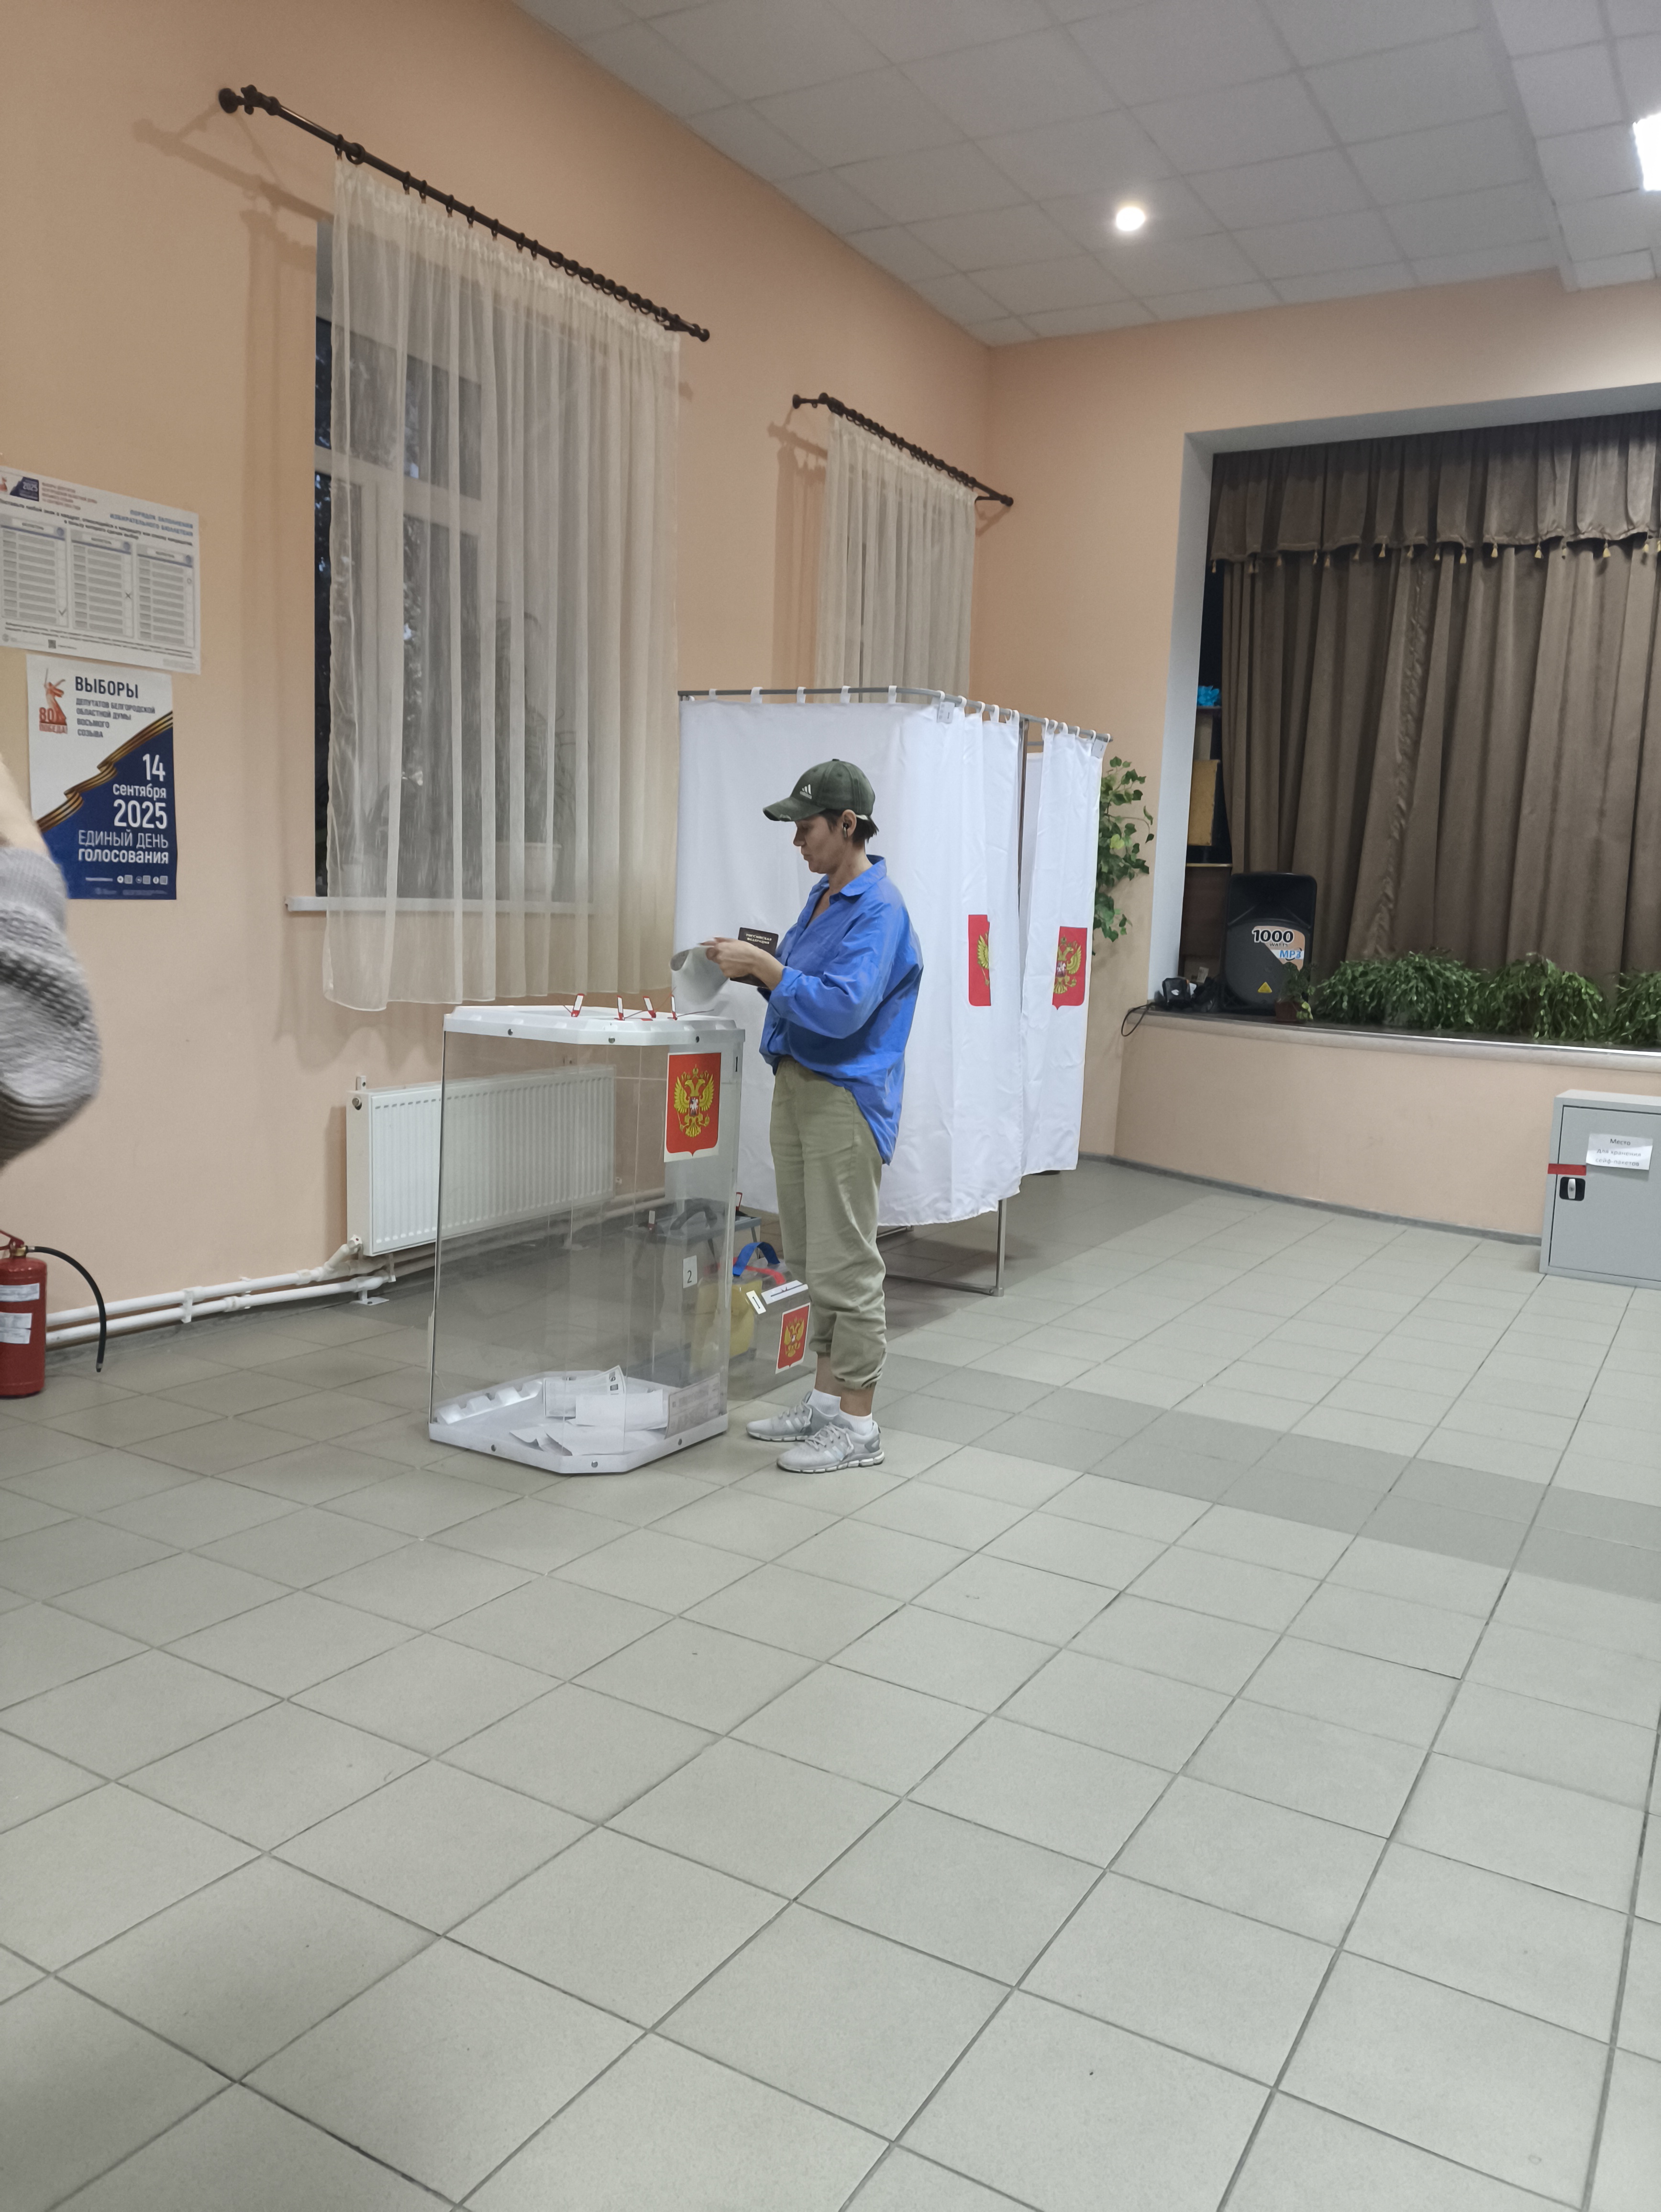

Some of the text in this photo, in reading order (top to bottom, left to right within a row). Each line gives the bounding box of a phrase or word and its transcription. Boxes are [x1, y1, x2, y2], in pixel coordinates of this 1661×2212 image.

[23, 482, 38, 492] 2025
[75, 676, 139, 698] ВЫБОРЫ
[76, 698, 155, 714] ДЕПУТАТОВ БЕЛГОРОДСКОЙ
[76, 708, 111, 718] ОБЛАСТНОЙ
[39, 707, 54, 723] 80
[77, 718, 110, 728] ВОСЬМОГО
[78, 729, 103, 738] СОЗЫВА
[142, 754, 166, 781] 14
[112, 784, 166, 800] сентября
[113, 799, 167, 829] 2025
[78, 829, 168, 849] ЕДИНЫЙ ДЕНЬ
[78, 849, 168, 864] голосования
[1252, 929, 1294, 943] 1000
[1280, 950, 1301, 959] MP3
[1595, 1158, 1639, 1166] сейф-пакетов
[687, 1270, 692, 1284] 2
